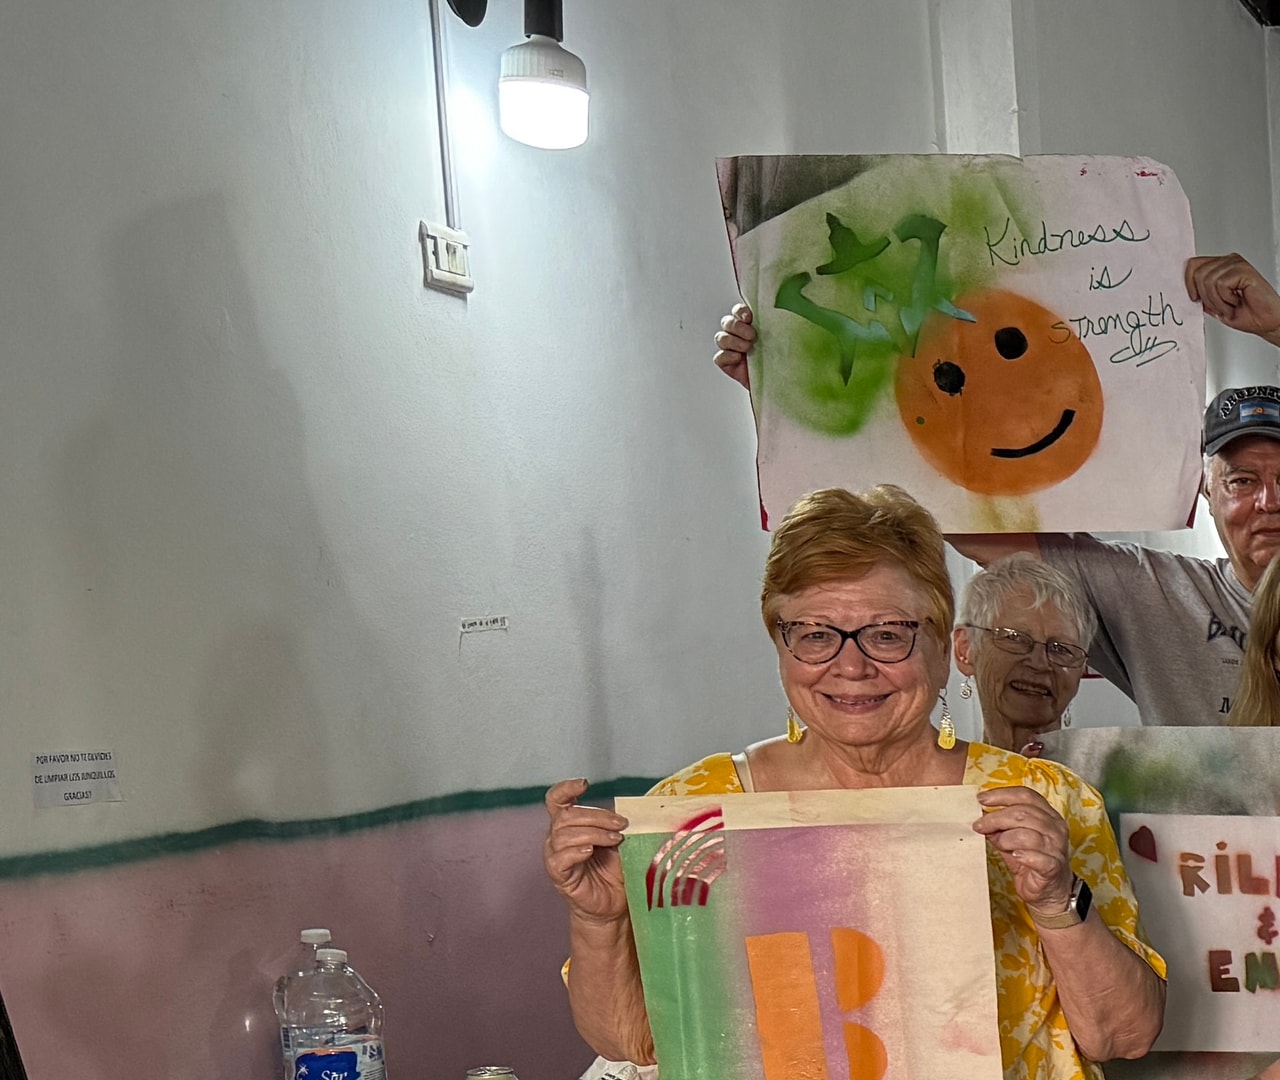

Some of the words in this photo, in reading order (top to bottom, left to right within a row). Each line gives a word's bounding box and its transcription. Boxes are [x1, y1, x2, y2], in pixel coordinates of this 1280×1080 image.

[984, 217, 1150, 266] Kindness
[1089, 265, 1133, 291] is
[49, 754, 69, 763] FAVOR
[70, 754, 80, 762] NO
[34, 775, 44, 784] DE
[44, 773, 69, 783] LIMPIAR
[69, 772, 81, 782] LOS
